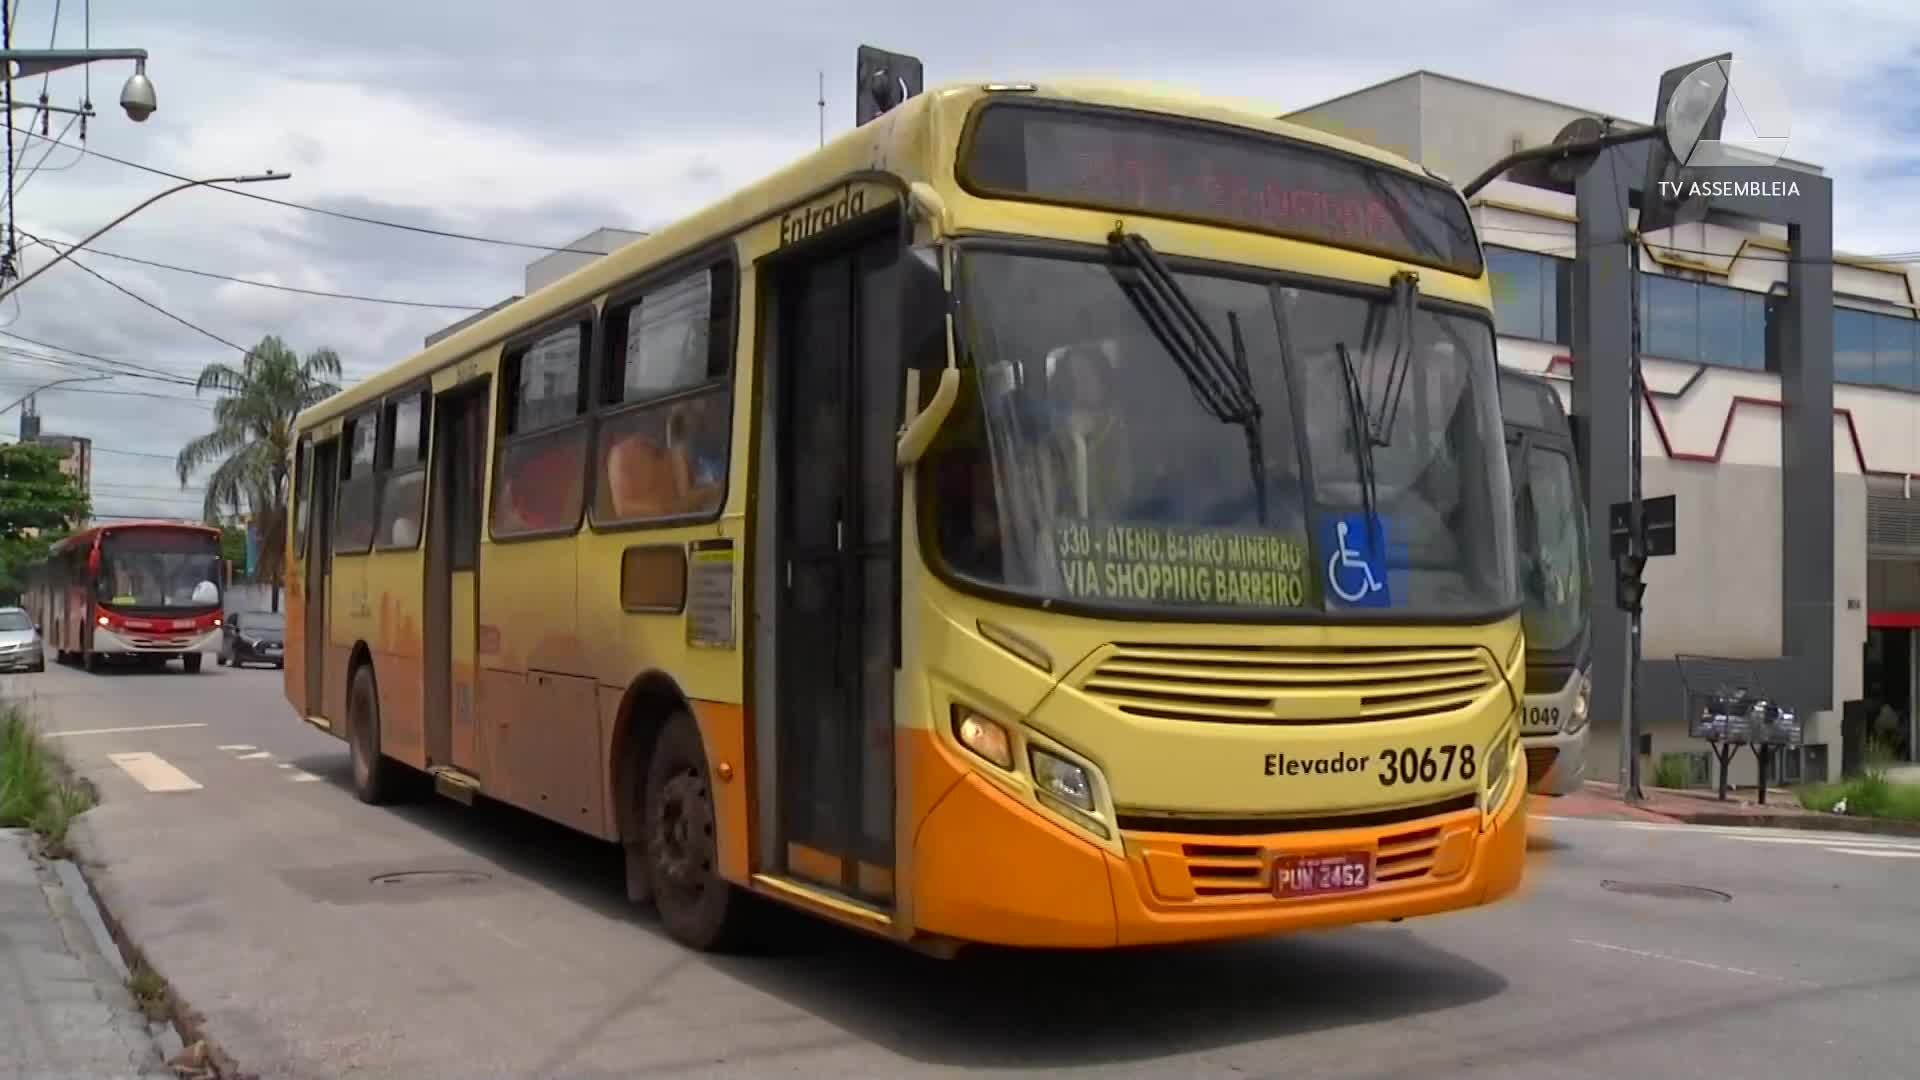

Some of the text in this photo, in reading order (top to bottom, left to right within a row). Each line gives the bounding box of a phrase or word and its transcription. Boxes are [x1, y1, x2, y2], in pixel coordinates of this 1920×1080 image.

[780, 183, 864, 249] Entrada
[1061, 560, 1302, 608] VIA SHOPPING BARREIRO
[1264, 744, 1476, 786] Elevador 30678
